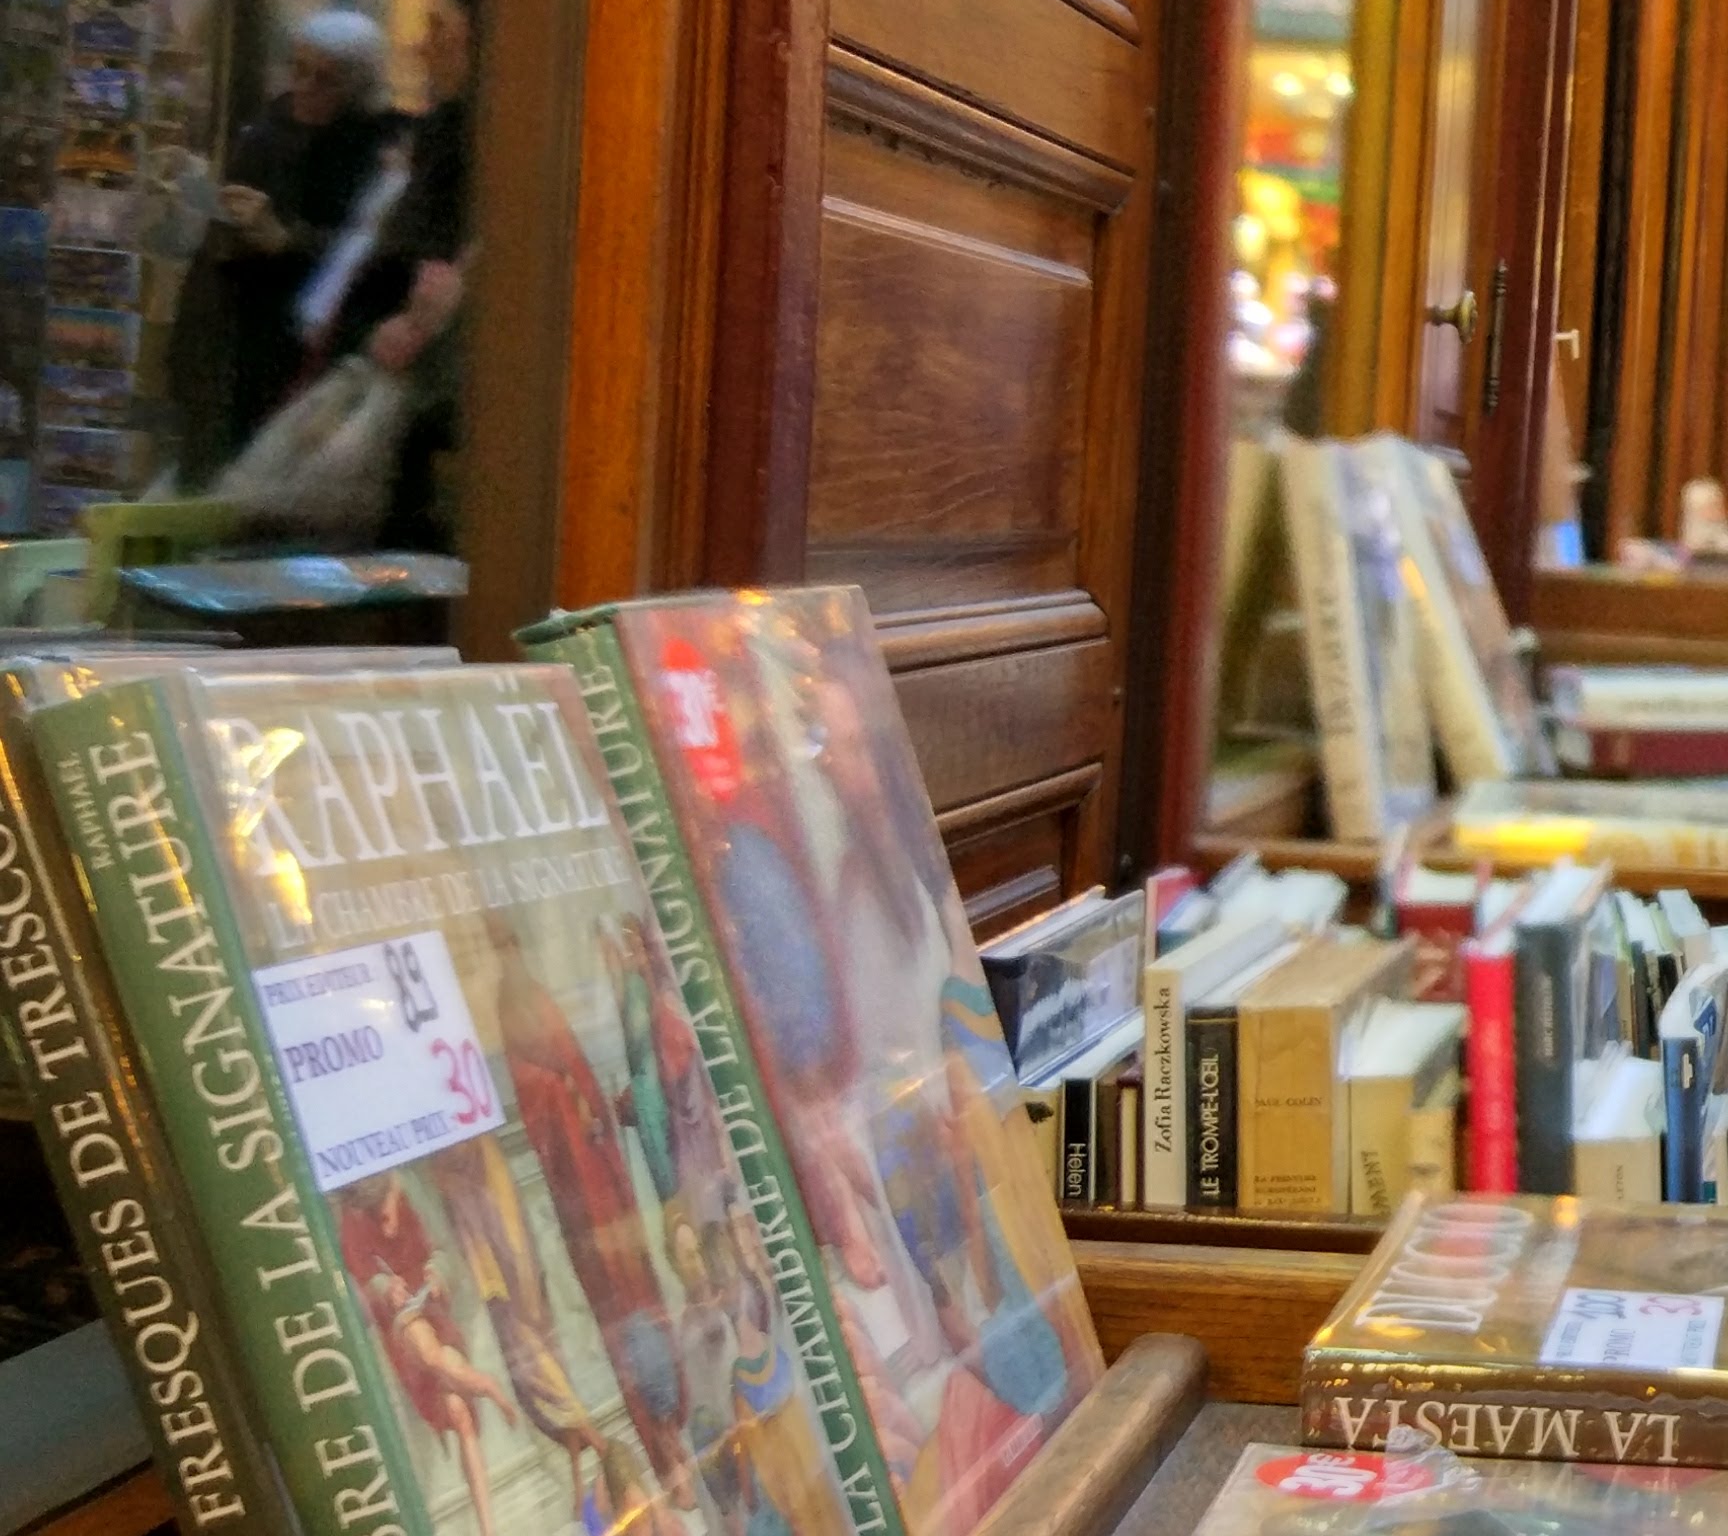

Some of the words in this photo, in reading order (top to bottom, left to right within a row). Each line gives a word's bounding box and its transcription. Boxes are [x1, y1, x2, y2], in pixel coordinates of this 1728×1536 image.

[440, 871, 482, 917] DE
[89, 730, 287, 1175] SIGNATURE
[284, 1025, 385, 1084] PROMO
[1154, 985, 1173, 1100] Raczkowska
[431, 1037, 493, 1125] 30
[52, 1090, 130, 1190] DE
[1154, 1100, 1173, 1154] Zofia
[1066, 1141, 1086, 1198] Helen
[1202, 1173, 1222, 1197] LE
[240, 1182, 325, 1292] LA
[90, 1196, 247, 1528] FRESQUES
[274, 1300, 363, 1414] DE
[1333, 1396, 1584, 1458] MAESTA
[1602, 1409, 1682, 1463] LA
